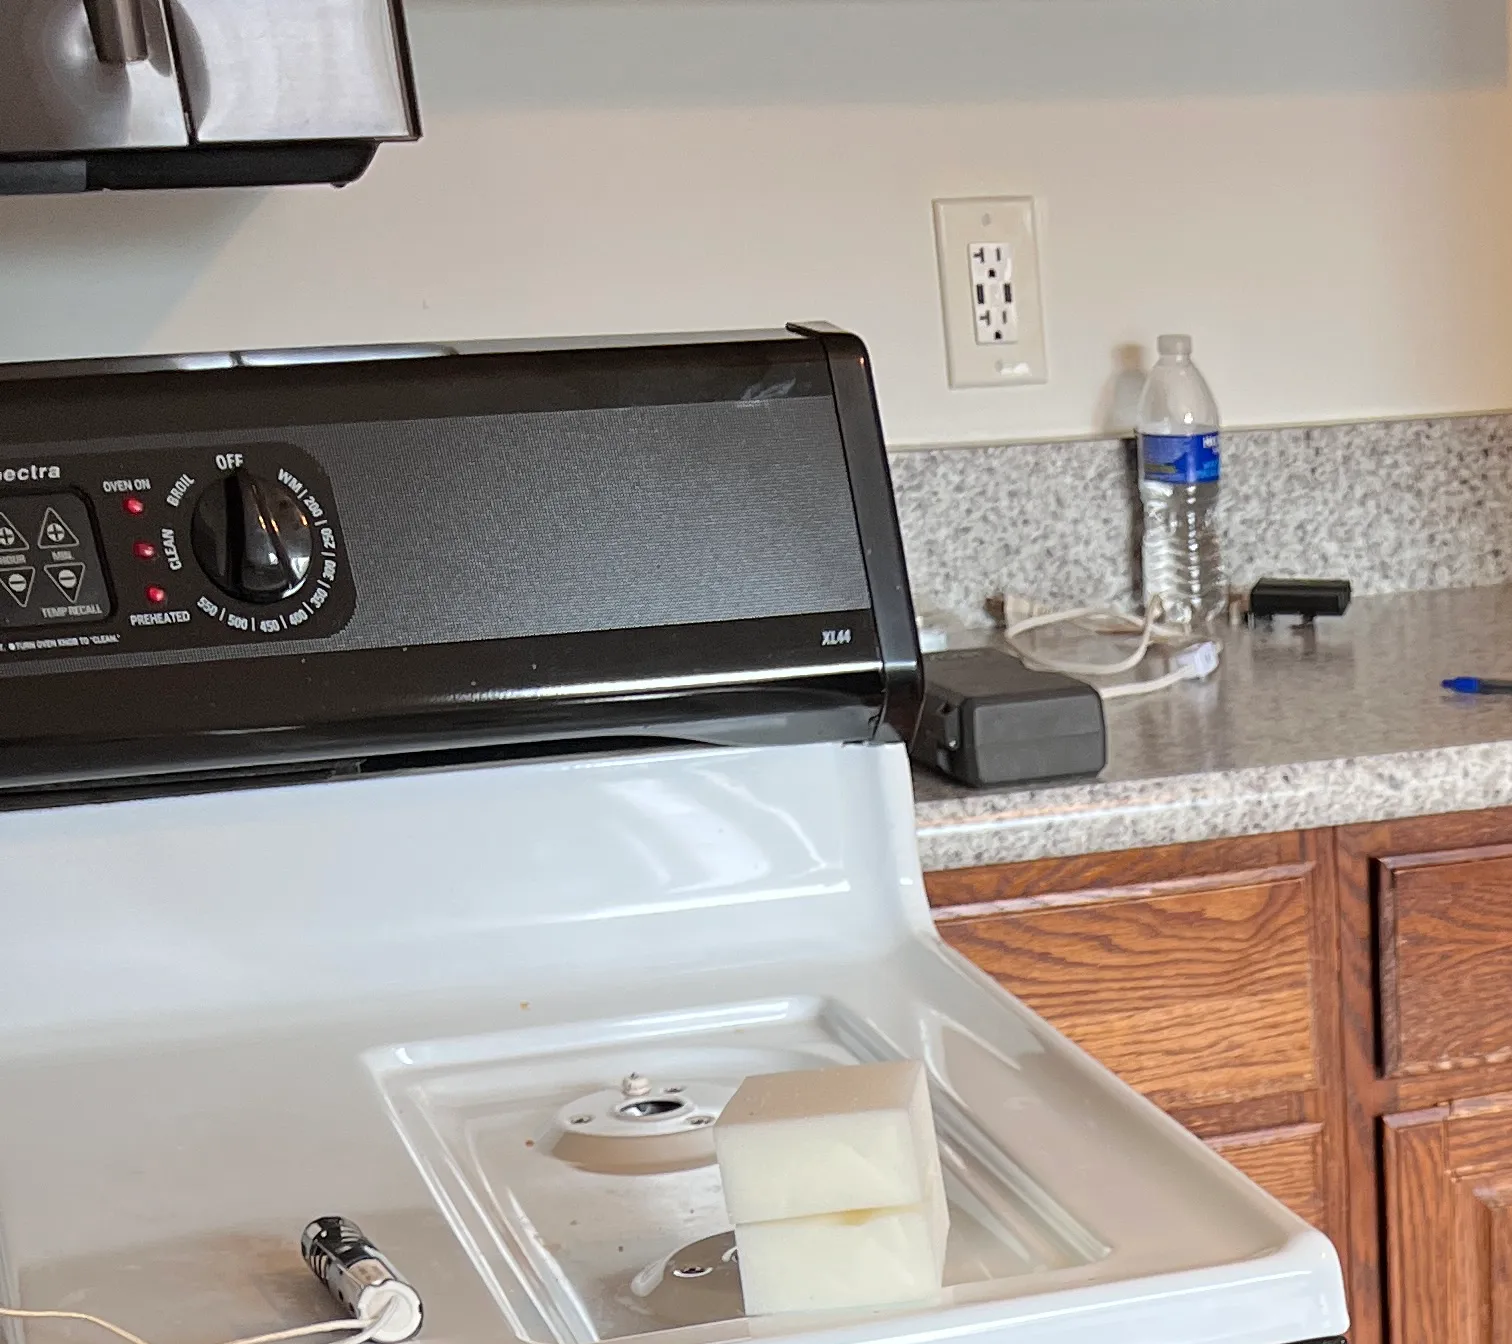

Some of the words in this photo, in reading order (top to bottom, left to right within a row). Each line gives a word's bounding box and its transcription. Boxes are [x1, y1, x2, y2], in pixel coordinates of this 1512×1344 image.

[215, 453, 244, 470] OFF
[0, 464, 61, 482] ectra
[277, 468, 303, 493] WM
[102, 479, 133, 493] OVEN
[133, 478, 151, 491] ON
[166, 473, 195, 507] BROIL
[303, 496, 324, 517] 200
[320, 527, 336, 549] 250
[161, 528, 182, 571] CLEAN
[322, 559, 337, 581] 300
[197, 596, 218, 617] 550
[310, 587, 328, 609] 350
[130, 610, 191, 626] PREHEATED
[227, 614, 249, 630] 500
[259, 619, 280, 633] 450
[289, 609, 308, 625] 400
